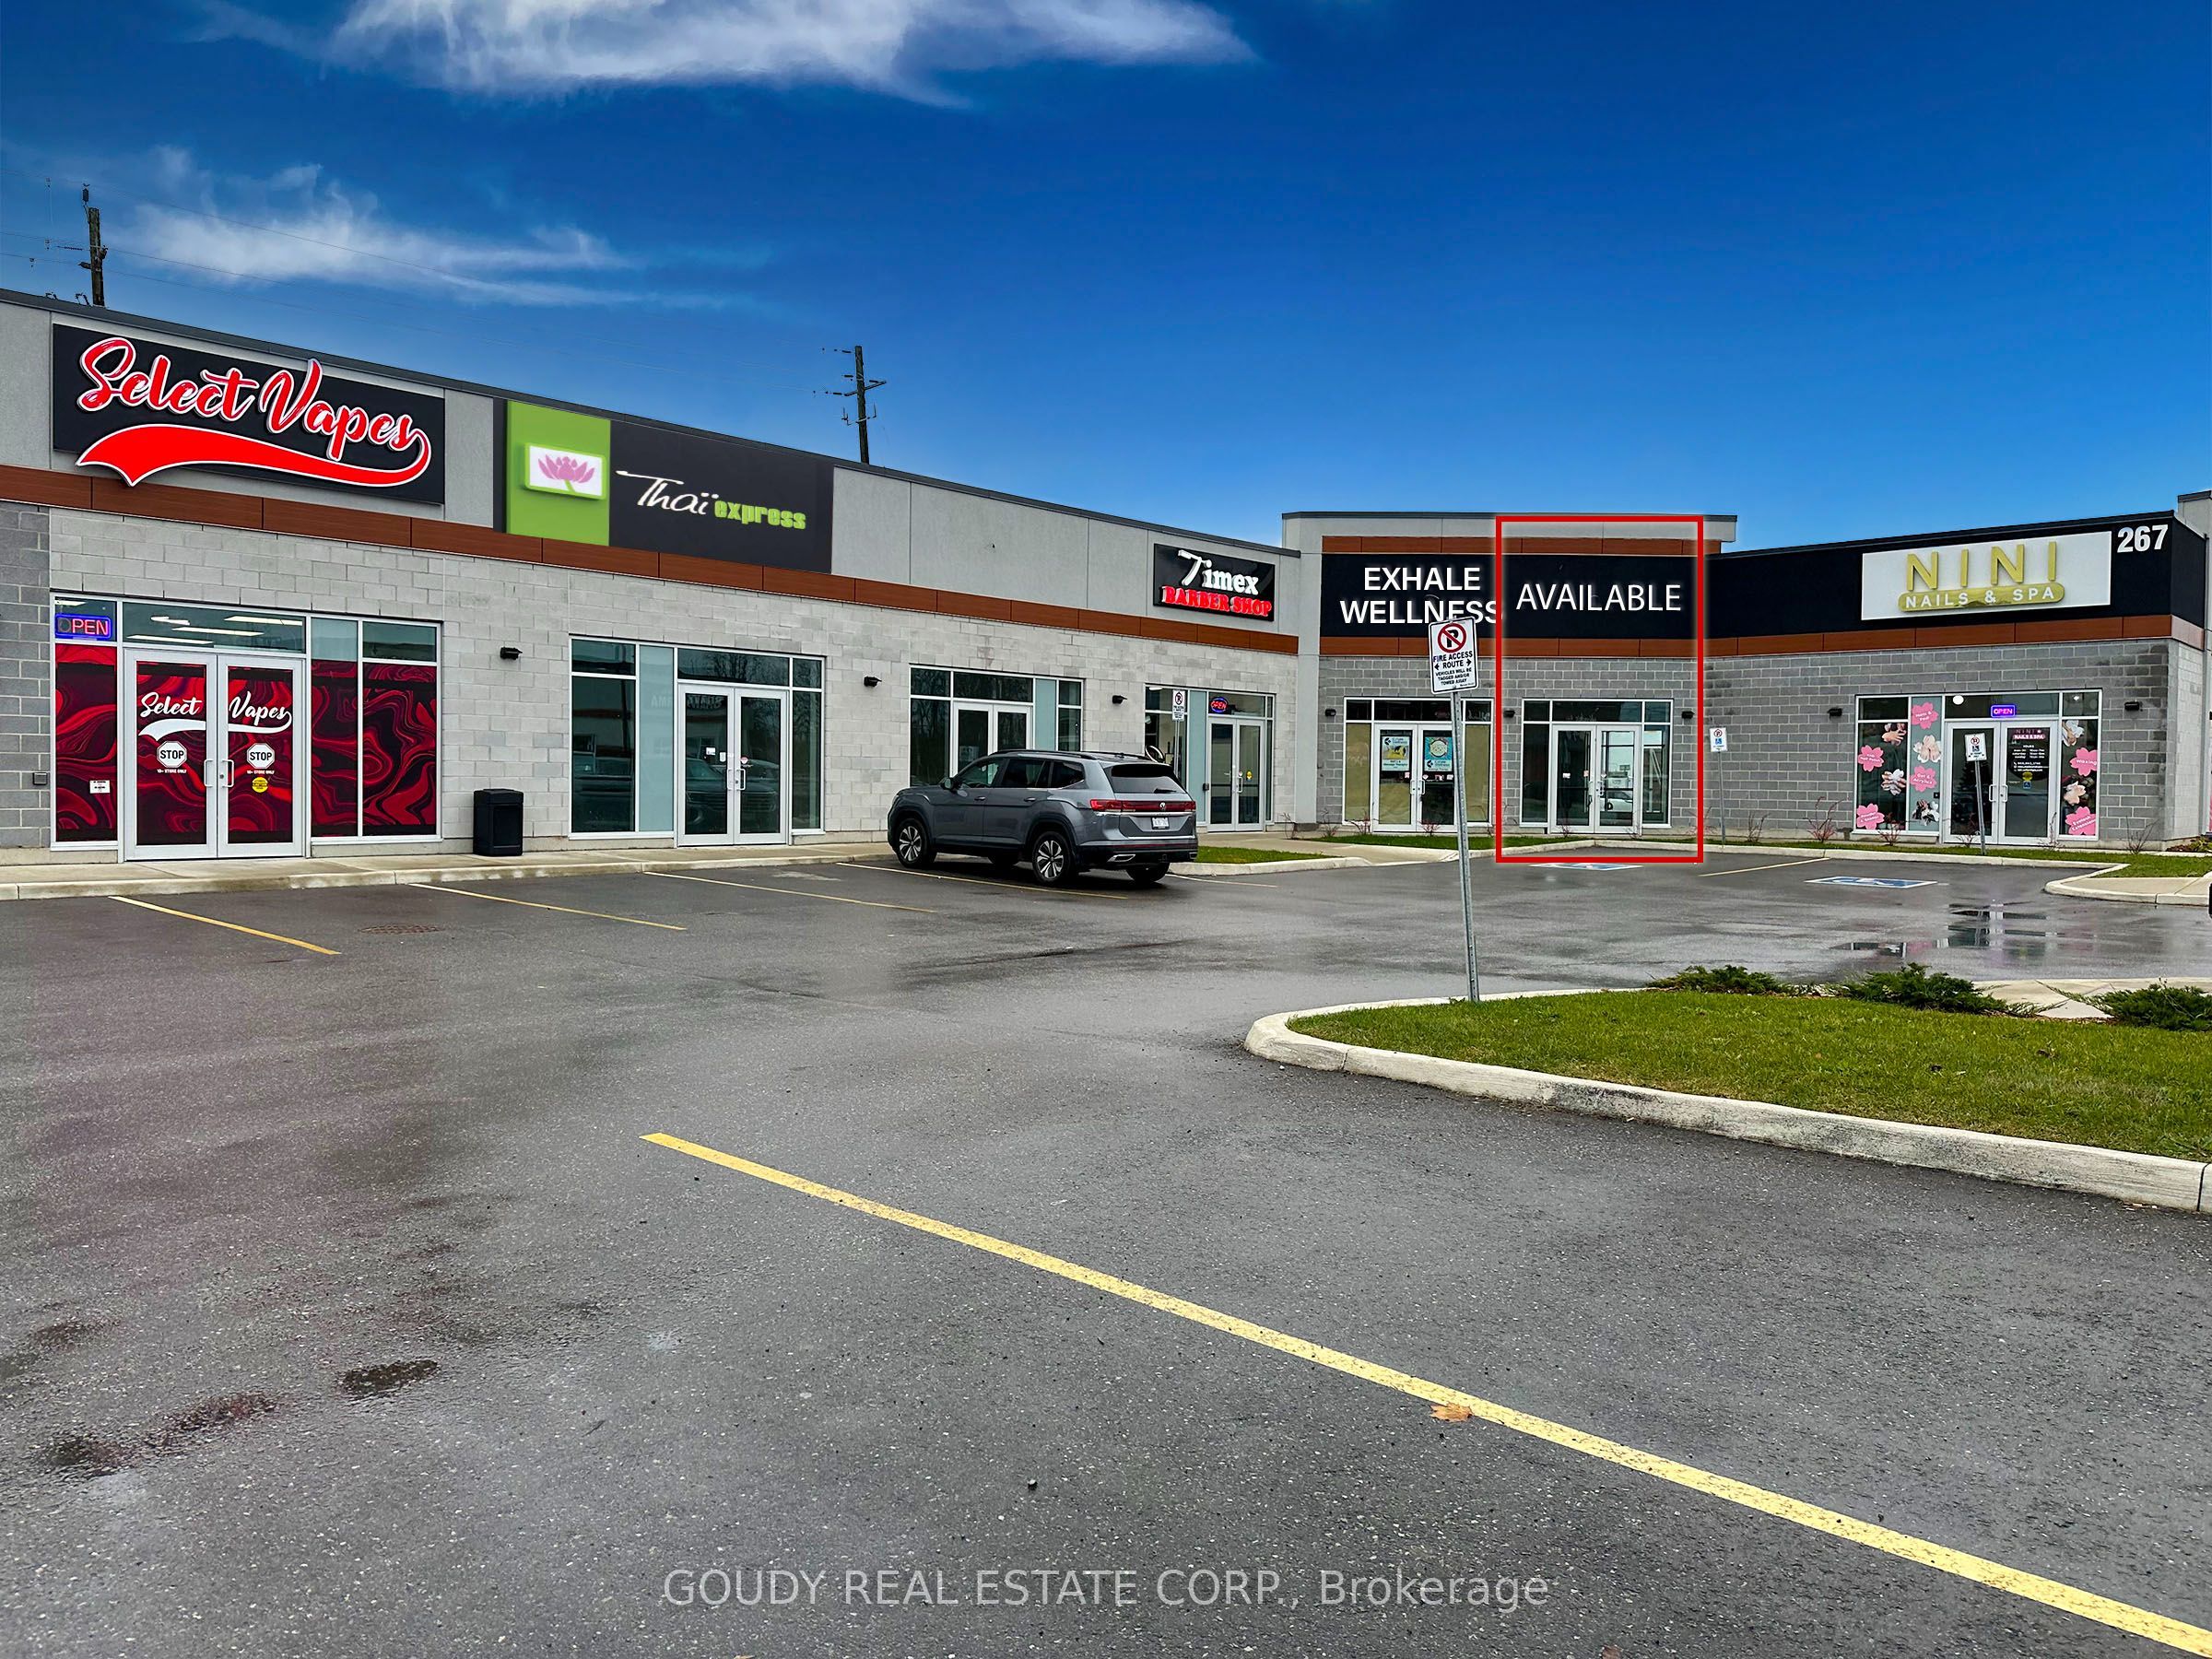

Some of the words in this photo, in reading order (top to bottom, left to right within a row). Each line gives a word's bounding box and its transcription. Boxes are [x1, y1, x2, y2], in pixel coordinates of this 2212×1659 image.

[77, 337, 259, 422] Select
[260, 358, 424, 461] Vapes
[714, 500, 806, 530] express
[2117, 524, 2169, 553] 267
[1178, 549, 1259, 595] Timex
[1906, 541, 2057, 592] NINI
[1364, 567, 1481, 591] EXHALE
[1161, 585, 1230, 612] BARBER
[1230, 595, 1272, 617] SHOP
[1516, 583, 1682, 611] AVAILABLE
[1906, 592, 1969, 608] NAILS
[1984, 590, 1996, 604] &
[2013, 586, 2054, 601] SPA
[1339, 600, 1503, 624] WELLNESS
[57, 618, 109, 635] OPEN
[1433, 654, 1447, 663] FIRE
[1448, 651, 1473, 661] ACCESS
[1442, 660, 1464, 669] ROUTE
[140, 691, 202, 718] Select
[229, 691, 288, 726] Vapes
[1211, 700, 1227, 709] OPEN
[160, 750, 184, 759] STOP
[249, 751, 272, 760] STOP
